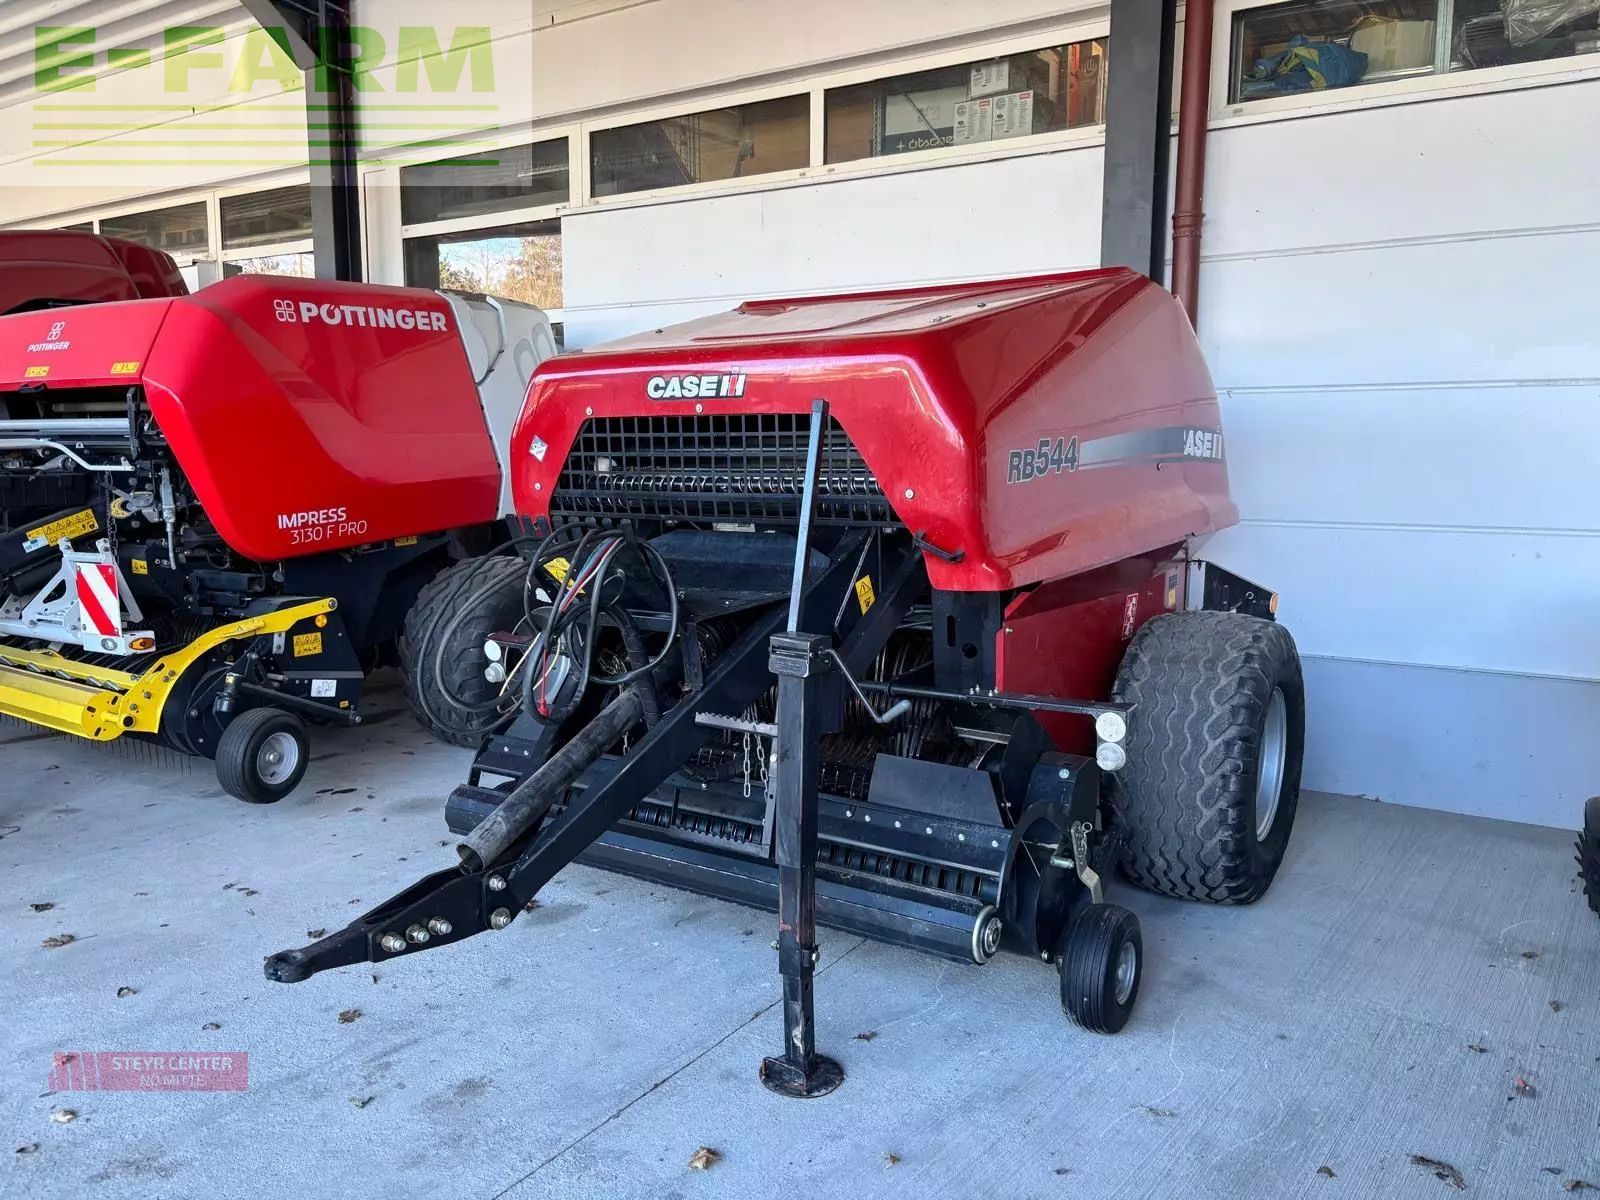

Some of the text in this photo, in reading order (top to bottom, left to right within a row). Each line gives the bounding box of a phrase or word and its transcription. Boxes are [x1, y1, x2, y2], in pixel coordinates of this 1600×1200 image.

[1183, 429, 1213, 458] ASE
[1007, 435, 1079, 485] RB544
[277, 506, 347, 529] IMPRESS
[290, 520, 368, 545] 3130 F PRO
